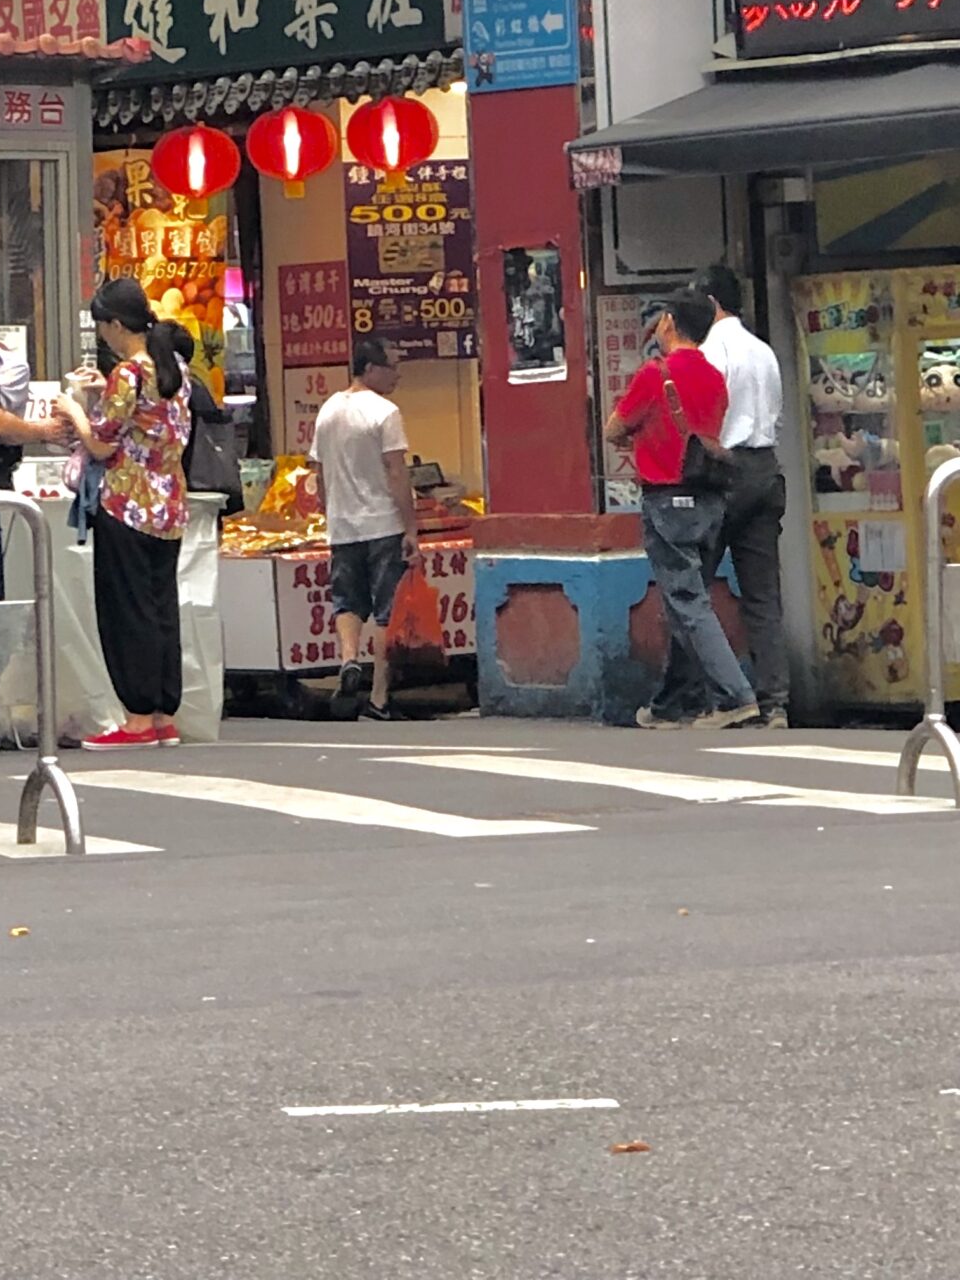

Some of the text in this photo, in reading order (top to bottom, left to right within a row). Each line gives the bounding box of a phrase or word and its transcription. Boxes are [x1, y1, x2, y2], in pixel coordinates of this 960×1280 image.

[353, 278, 415, 287] Master
[368, 285, 429, 295] Chung
[420, 297, 466, 319] 500
[354, 308, 373, 332] 8
